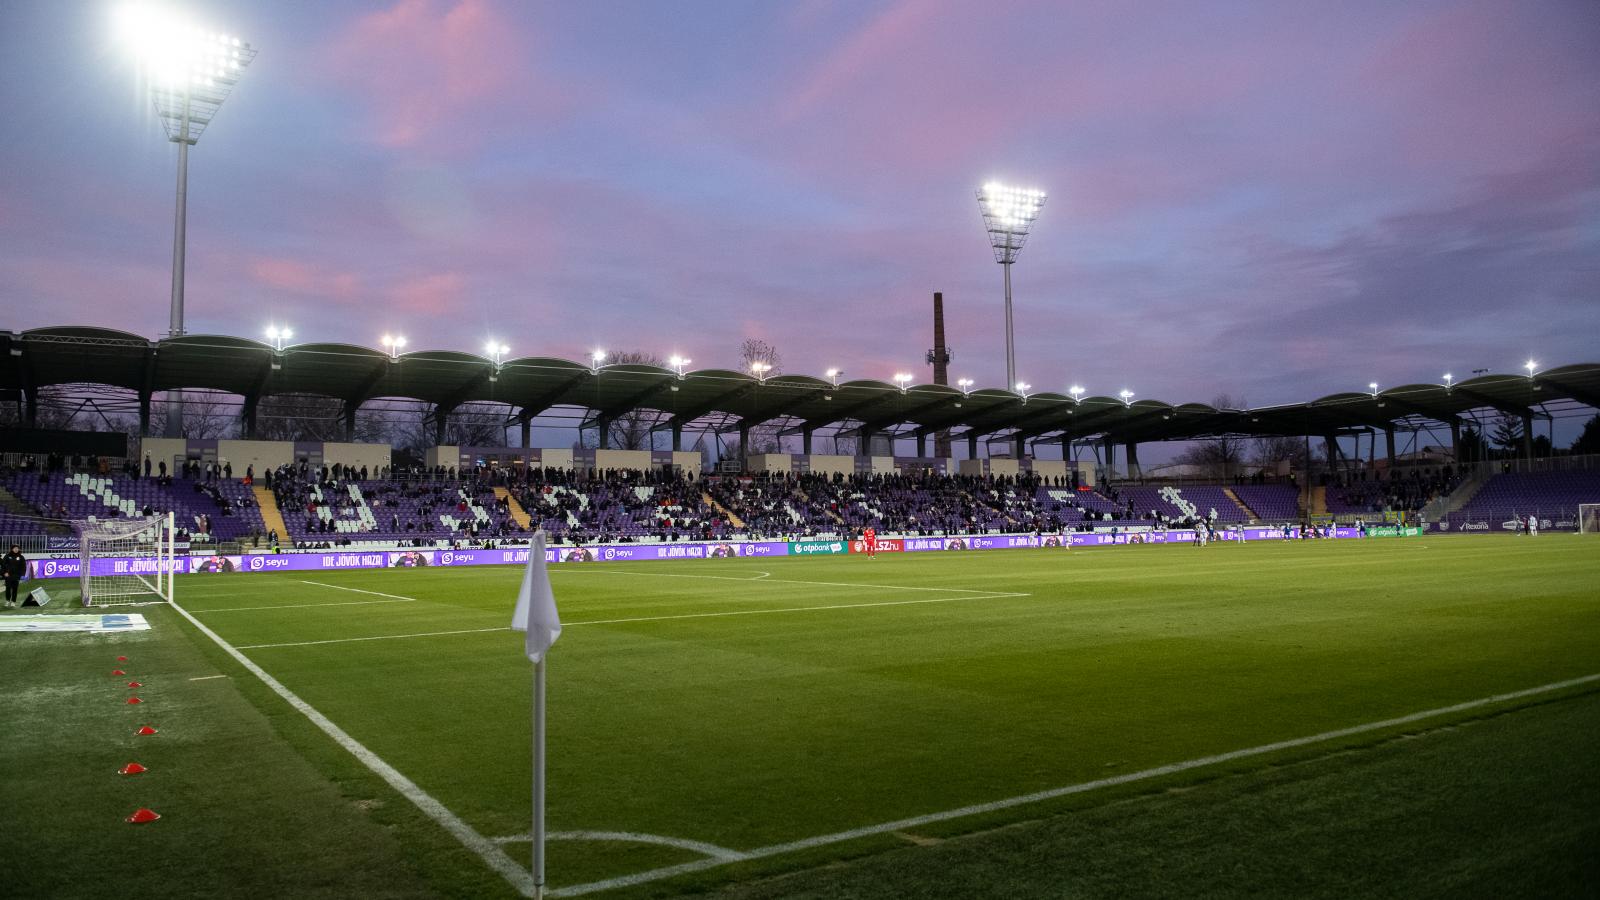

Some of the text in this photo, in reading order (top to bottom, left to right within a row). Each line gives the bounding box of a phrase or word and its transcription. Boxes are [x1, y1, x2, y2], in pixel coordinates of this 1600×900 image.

[1465, 522, 1489, 530] Rexona
[755, 545, 770, 553] seyu
[803, 543, 830, 554] otpbank
[454, 553, 474, 562] seyu
[503, 552, 514, 562] IDE
[514, 549, 529, 561] JÖV
[616, 549, 633, 558] seyu
[266, 558, 289, 568] seyu
[322, 554, 383, 567] IDE JÖVÖK HAZA!
[58, 564, 79, 573] seyu
[114, 560, 129, 573] IDE
[129, 558, 158, 573] JÖVÖK
